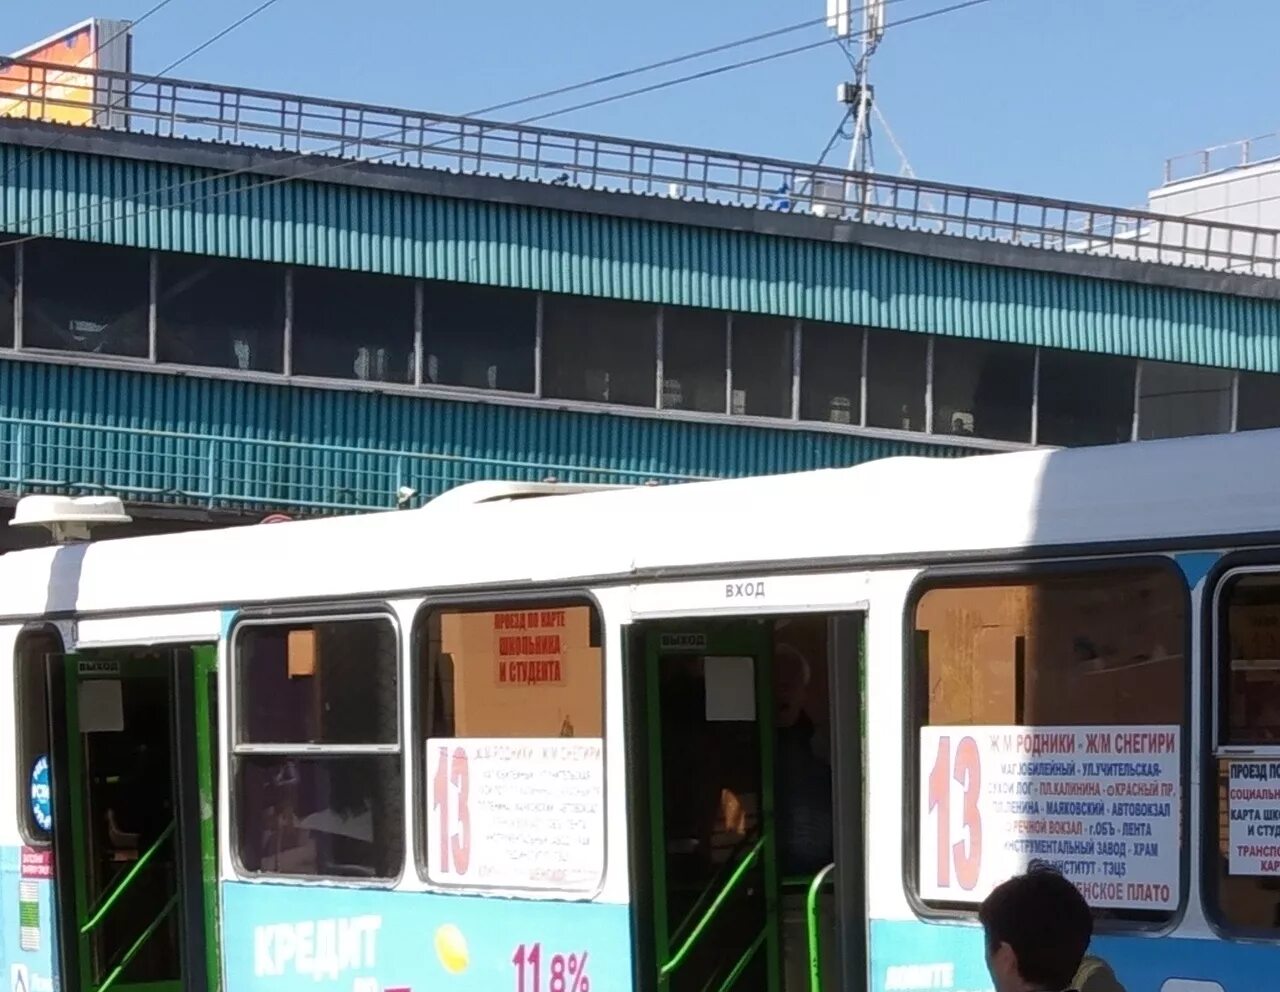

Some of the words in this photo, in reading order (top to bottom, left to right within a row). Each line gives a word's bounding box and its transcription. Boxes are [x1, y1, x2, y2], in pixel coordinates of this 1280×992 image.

[725, 581, 766, 599] ВХОД
[494, 612, 526, 631] ПРОЕЗД
[527, 611, 539, 629] ПО
[540, 610, 566, 628] КАРТЕ
[499, 634, 561, 656] ШКОЛЬНИКА
[499, 660, 507, 682] И
[509, 660, 561, 686] СТУДЕНТА
[1016, 733, 1075, 757] РОДНИКИ
[1114, 733, 1176, 754] СНЕГИРИ
[1230, 763, 1268, 782] ПРОЕЗД
[928, 735, 983, 890] 13
[1045, 800, 1106, 816] МАЯКОВСКИЙ
[1111, 802, 1172, 817] АВТОВОКЗАЛ
[1230, 809, 1263, 821] КАРТА
[1049, 820, 1083, 836] ВОКЗАЛ
[1122, 822, 1153, 837] ЛЕНТА
[1247, 825, 1255, 837] И
[1097, 841, 1127, 859] ЗАВОД
[1133, 842, 1159, 858] ХРАМ
[1127, 884, 1171, 903] ПЛАТО
[253, 913, 383, 982] КРЕДИТ
